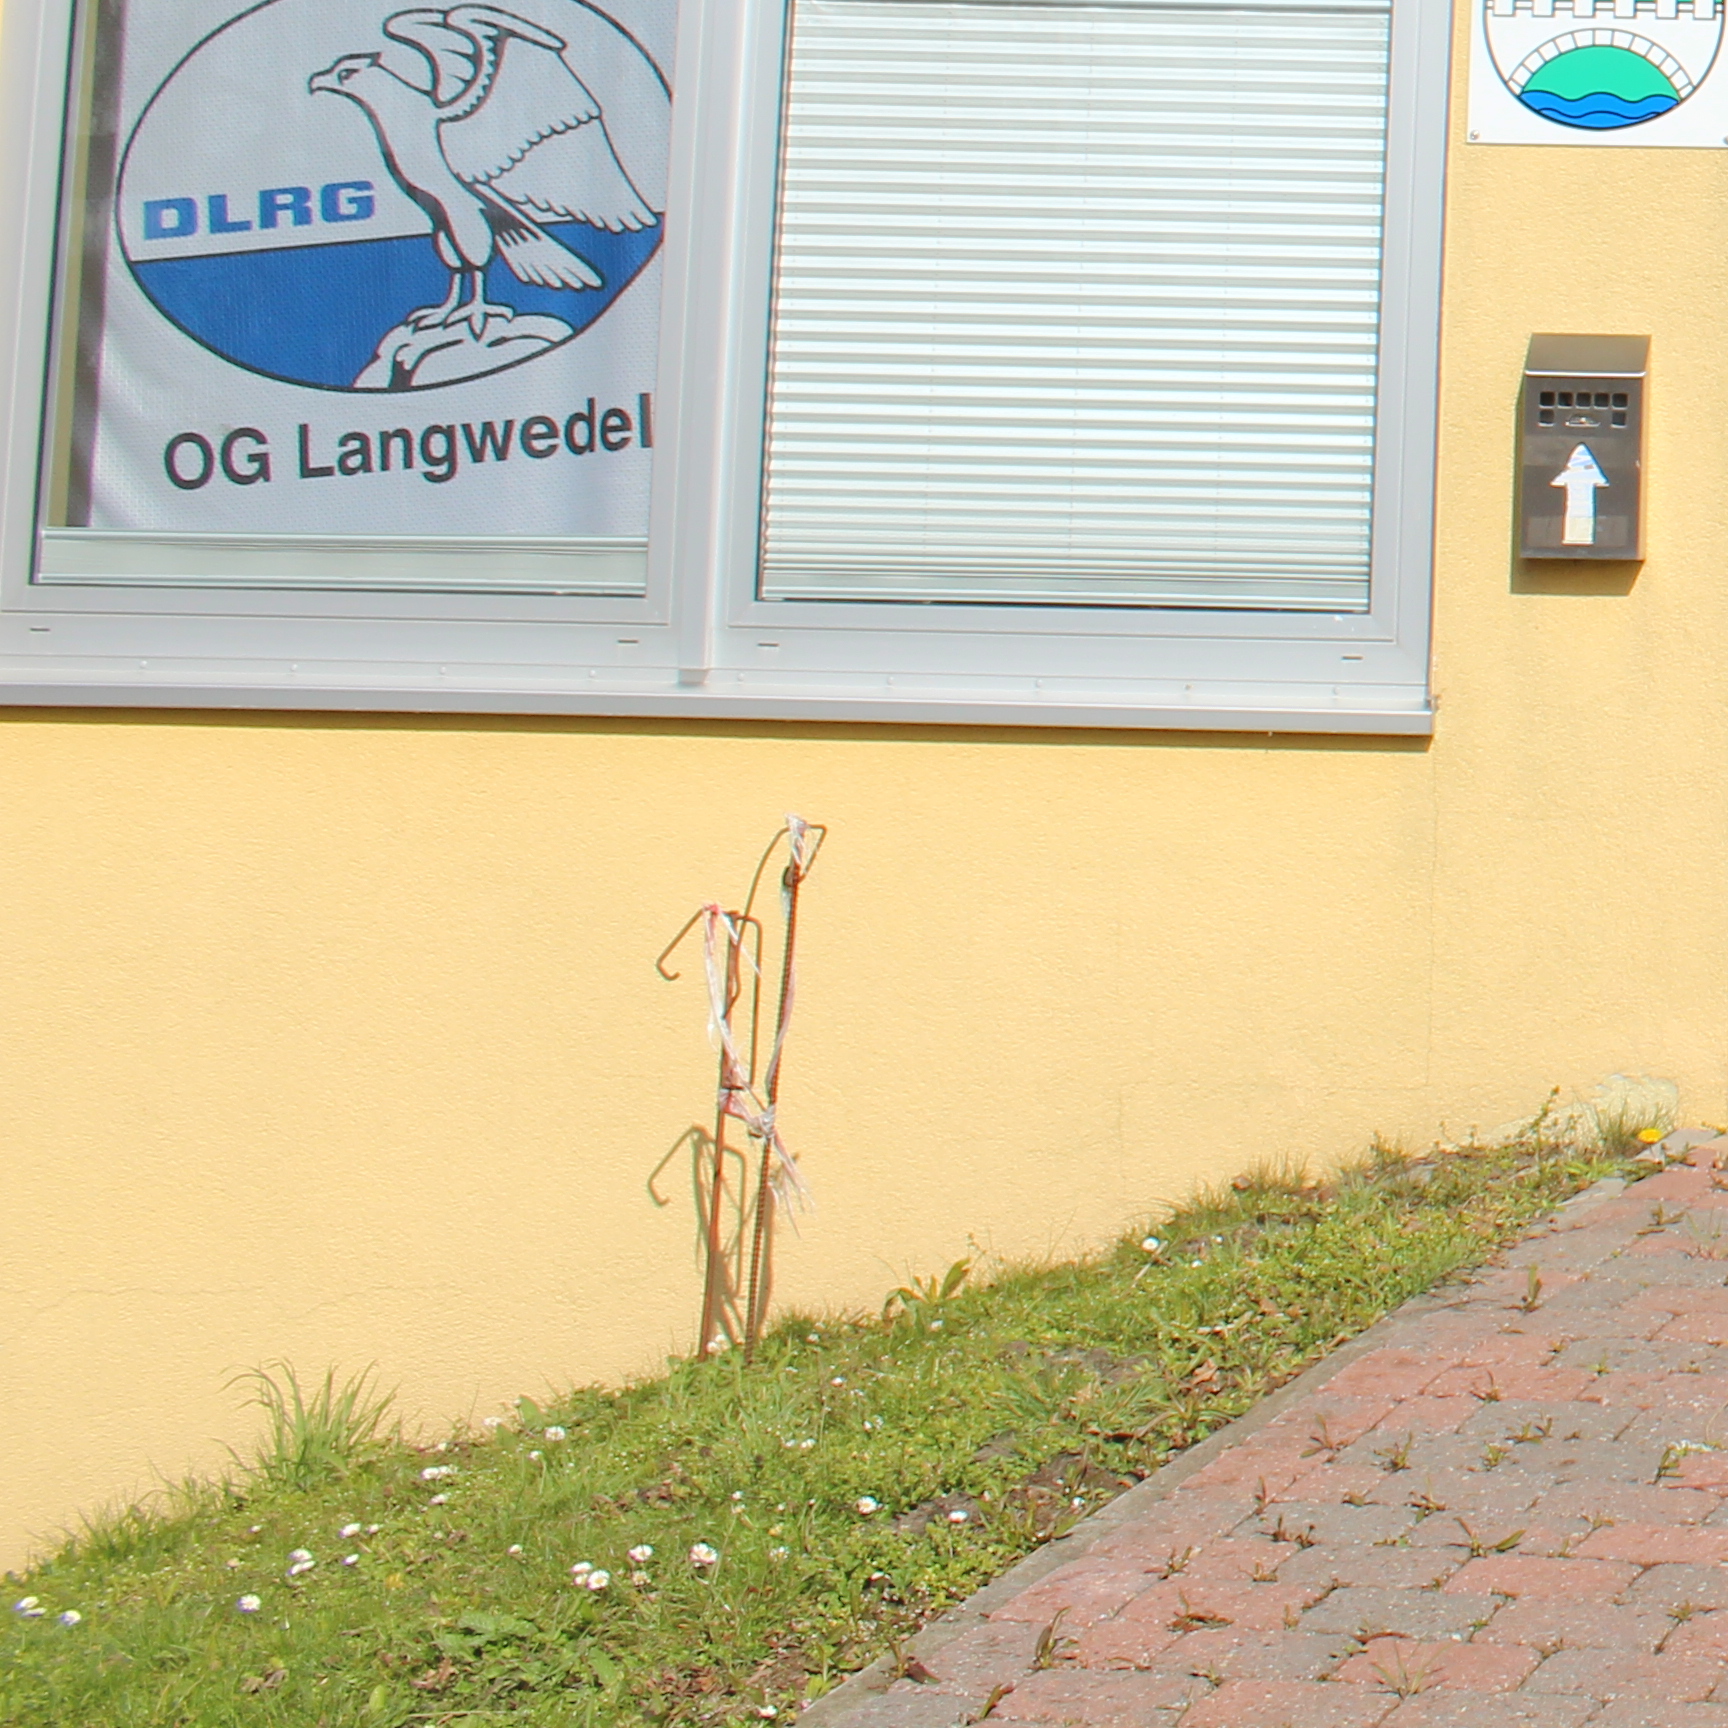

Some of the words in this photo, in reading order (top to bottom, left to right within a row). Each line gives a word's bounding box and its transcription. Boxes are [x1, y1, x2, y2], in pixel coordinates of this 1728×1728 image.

[143, 179, 376, 241] DLRG
[163, 426, 273, 491] OG
[298, 391, 655, 484] Langwedel
